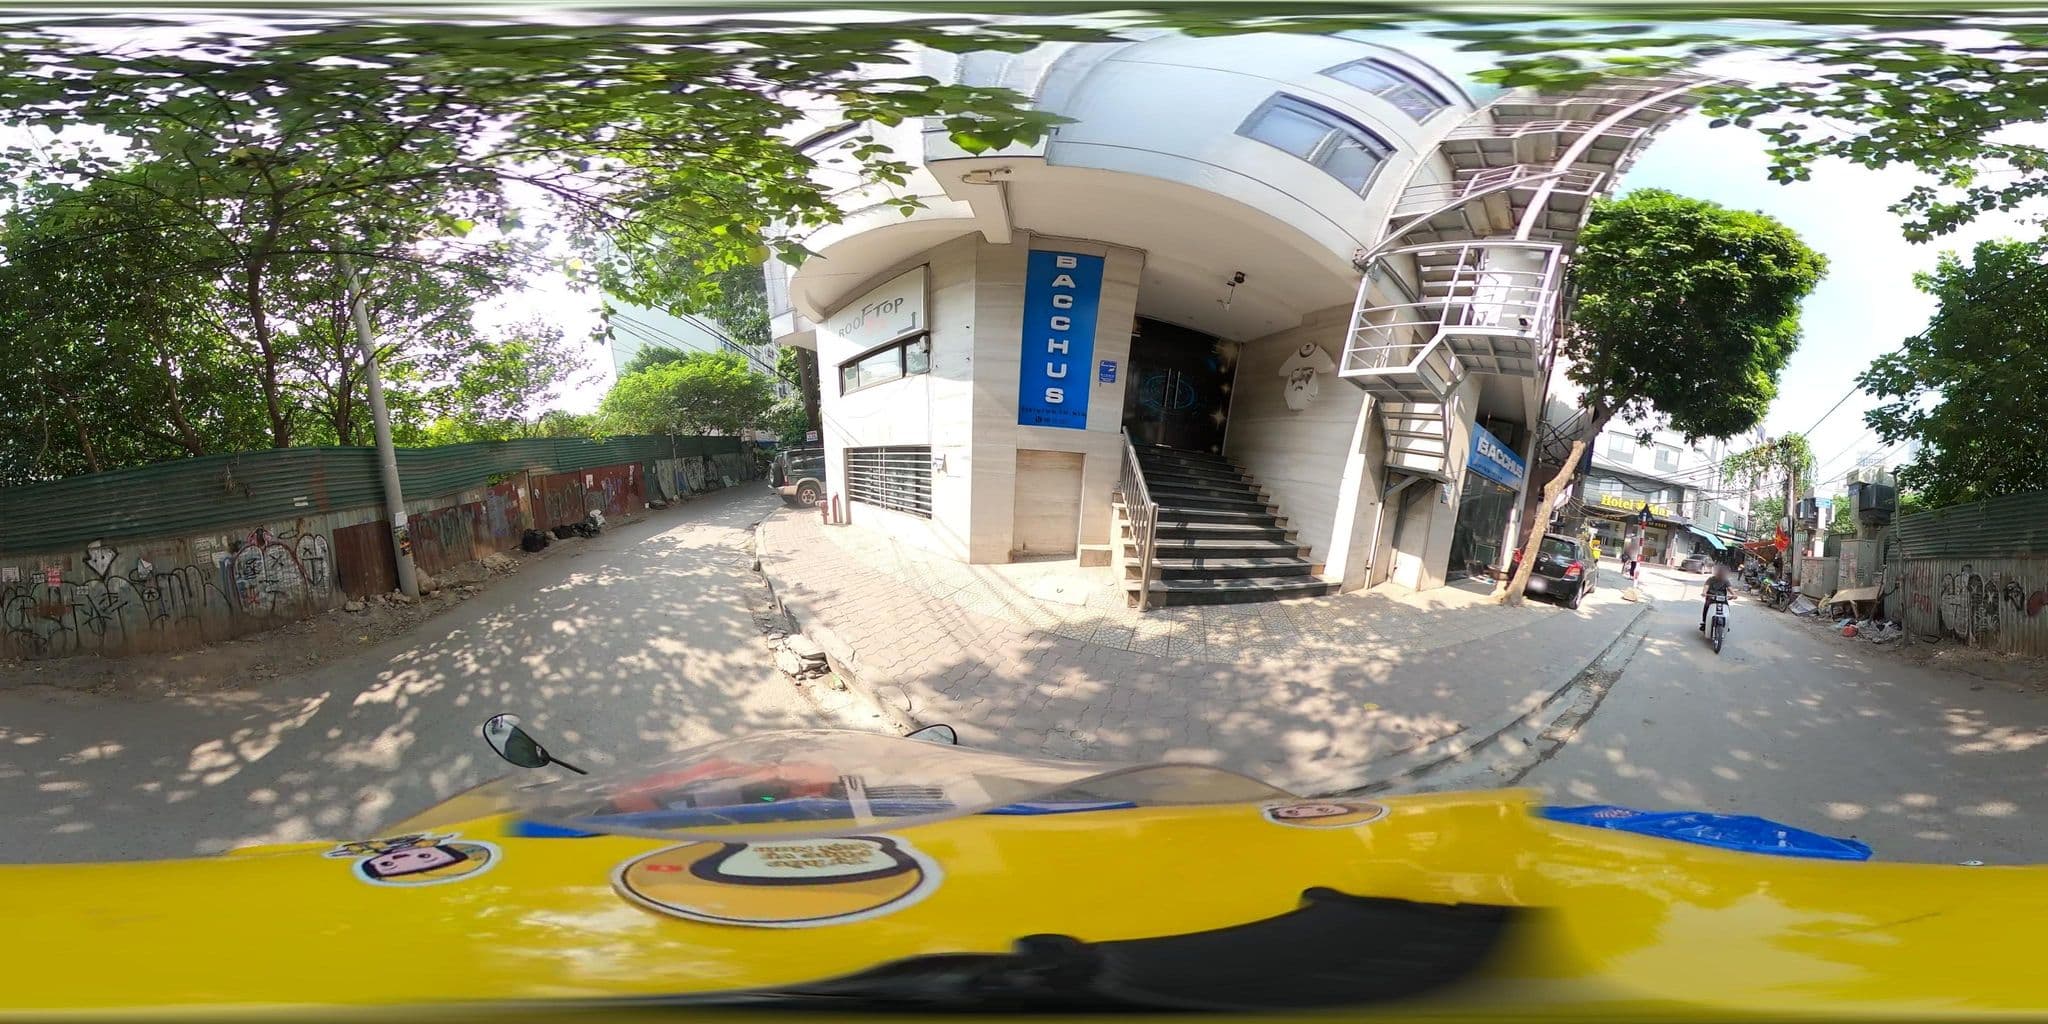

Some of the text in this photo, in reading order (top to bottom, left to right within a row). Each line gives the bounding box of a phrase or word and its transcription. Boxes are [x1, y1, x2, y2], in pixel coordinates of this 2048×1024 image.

[1045, 255, 1078, 404] BACCHUS
[1477, 436, 1524, 478] BACCHUS
[1600, 493, 1634, 510] Hotel
